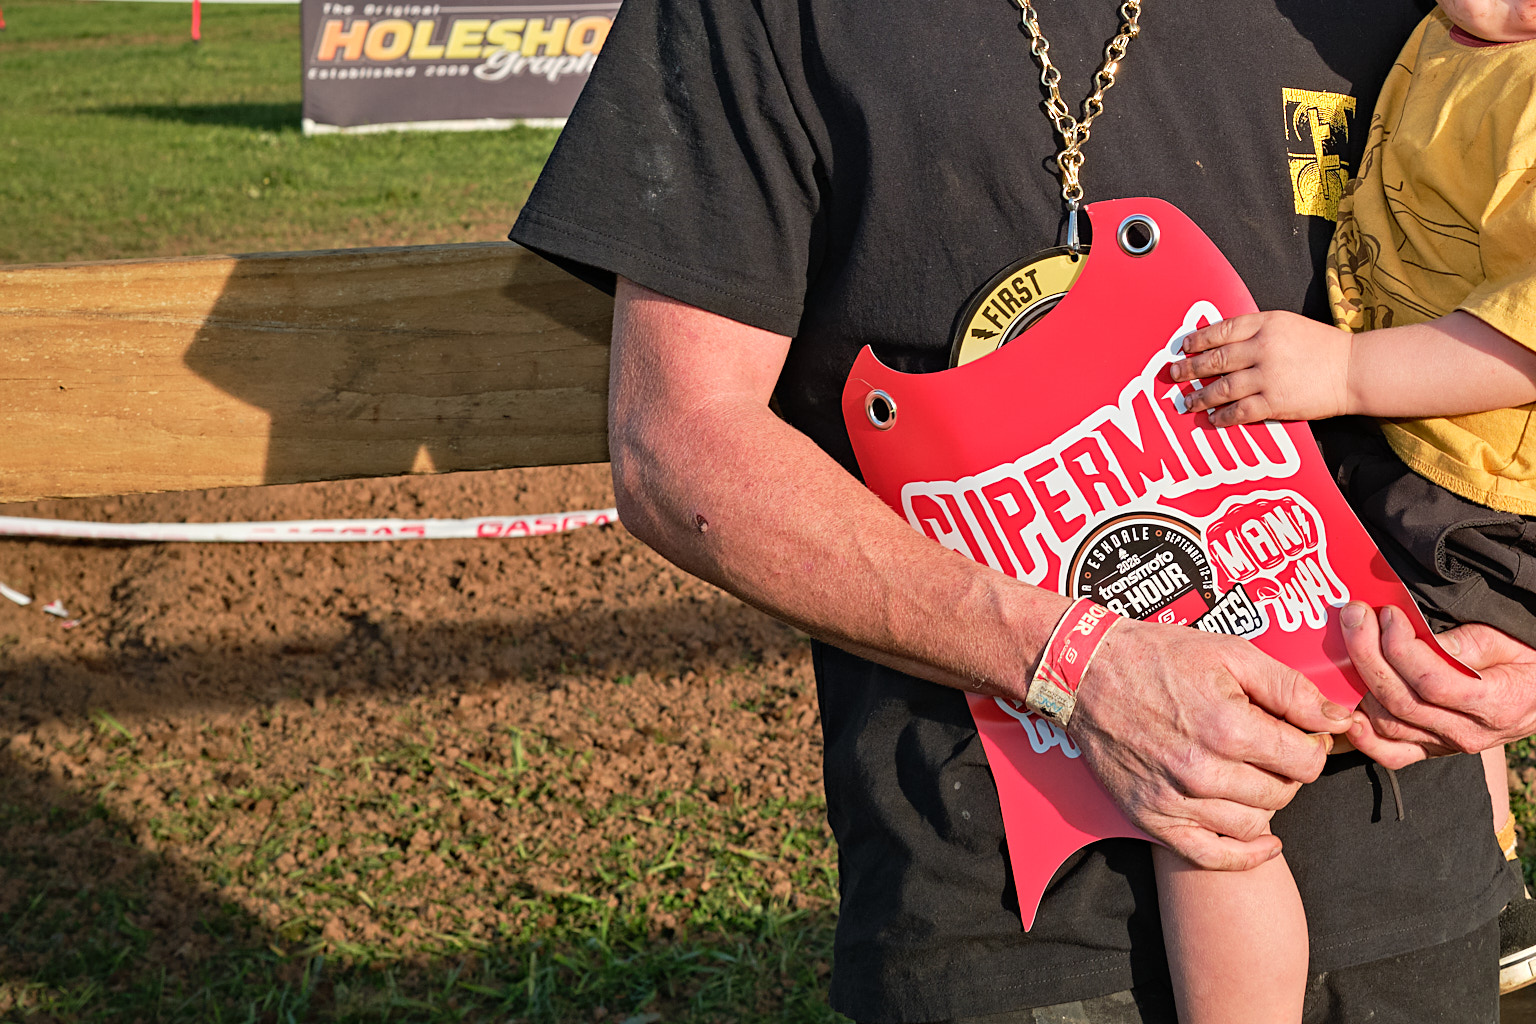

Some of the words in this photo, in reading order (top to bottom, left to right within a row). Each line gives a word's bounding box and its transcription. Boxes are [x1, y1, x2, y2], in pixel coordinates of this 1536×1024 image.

[323, 3, 354, 16] The
[364, 3, 441, 17] Original
[308, 66, 416, 80] Established
[982, 268, 1042, 330] FIRST
[1116, 553, 1142, 575] 2026
[1164, 530, 1206, 566] SEPTEMBER
[1098, 550, 1174, 600] transmoto
[1106, 562, 1191, 619] 8-HOUR
